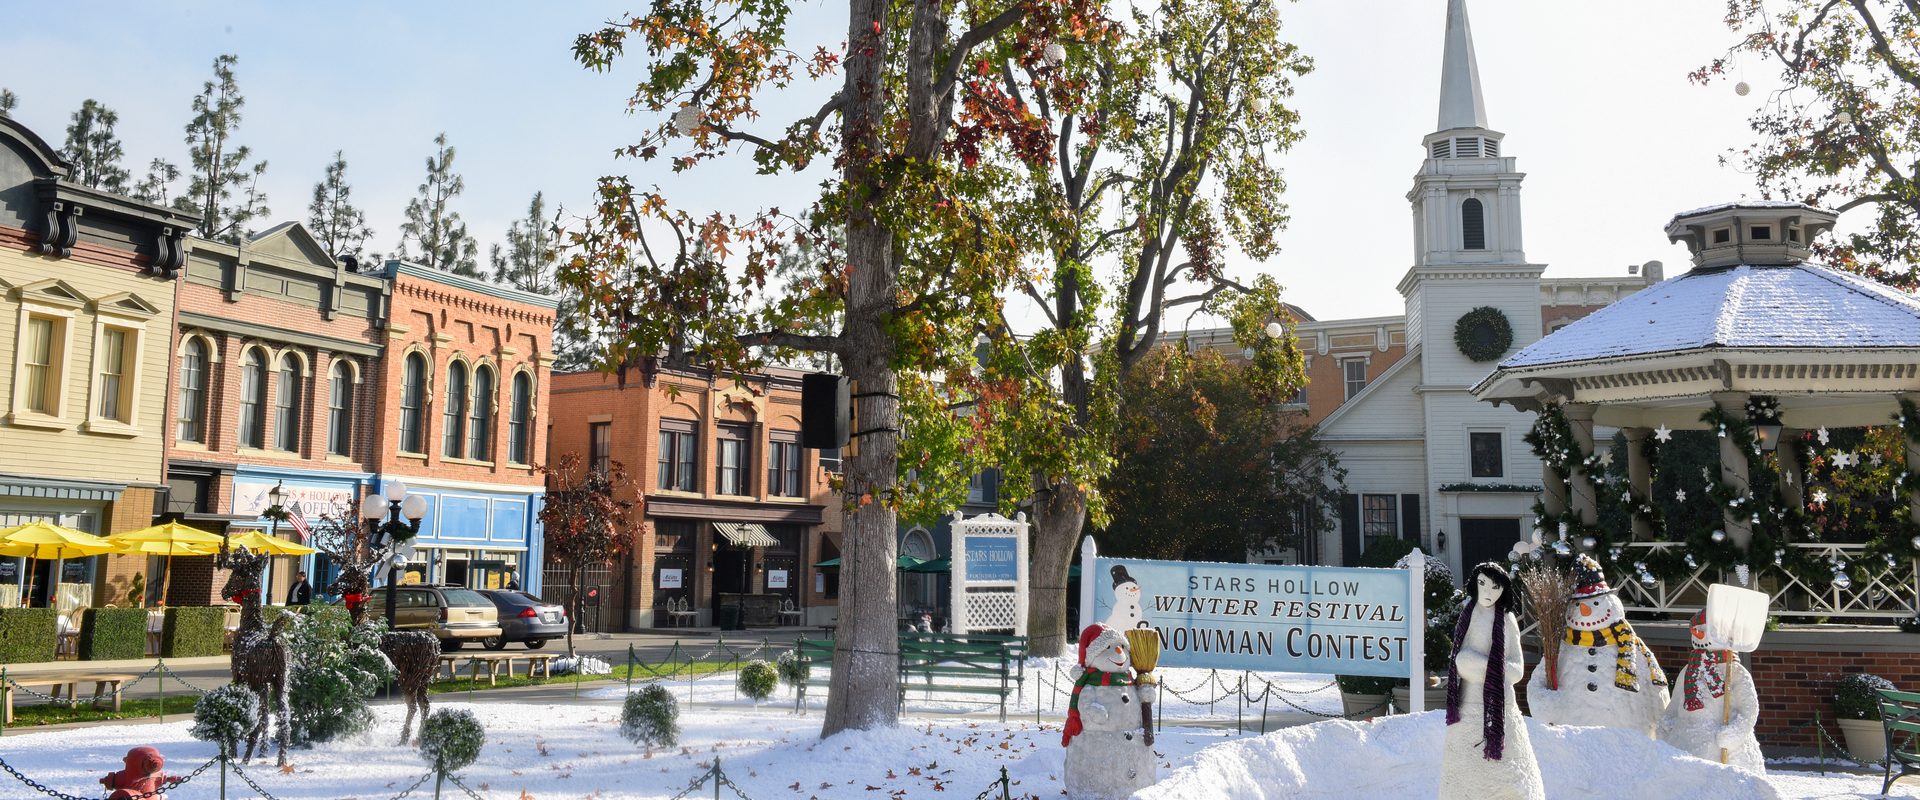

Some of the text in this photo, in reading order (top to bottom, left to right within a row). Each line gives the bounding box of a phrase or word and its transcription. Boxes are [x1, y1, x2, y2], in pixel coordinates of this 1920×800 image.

[966, 550, 1014, 562] STARS HOLLOW
[1188, 575, 1360, 597] STARS HOLLOW
[1154, 595, 1405, 622] WINTER FESTIVAL
[1286, 627, 1408, 662] CONTEST
